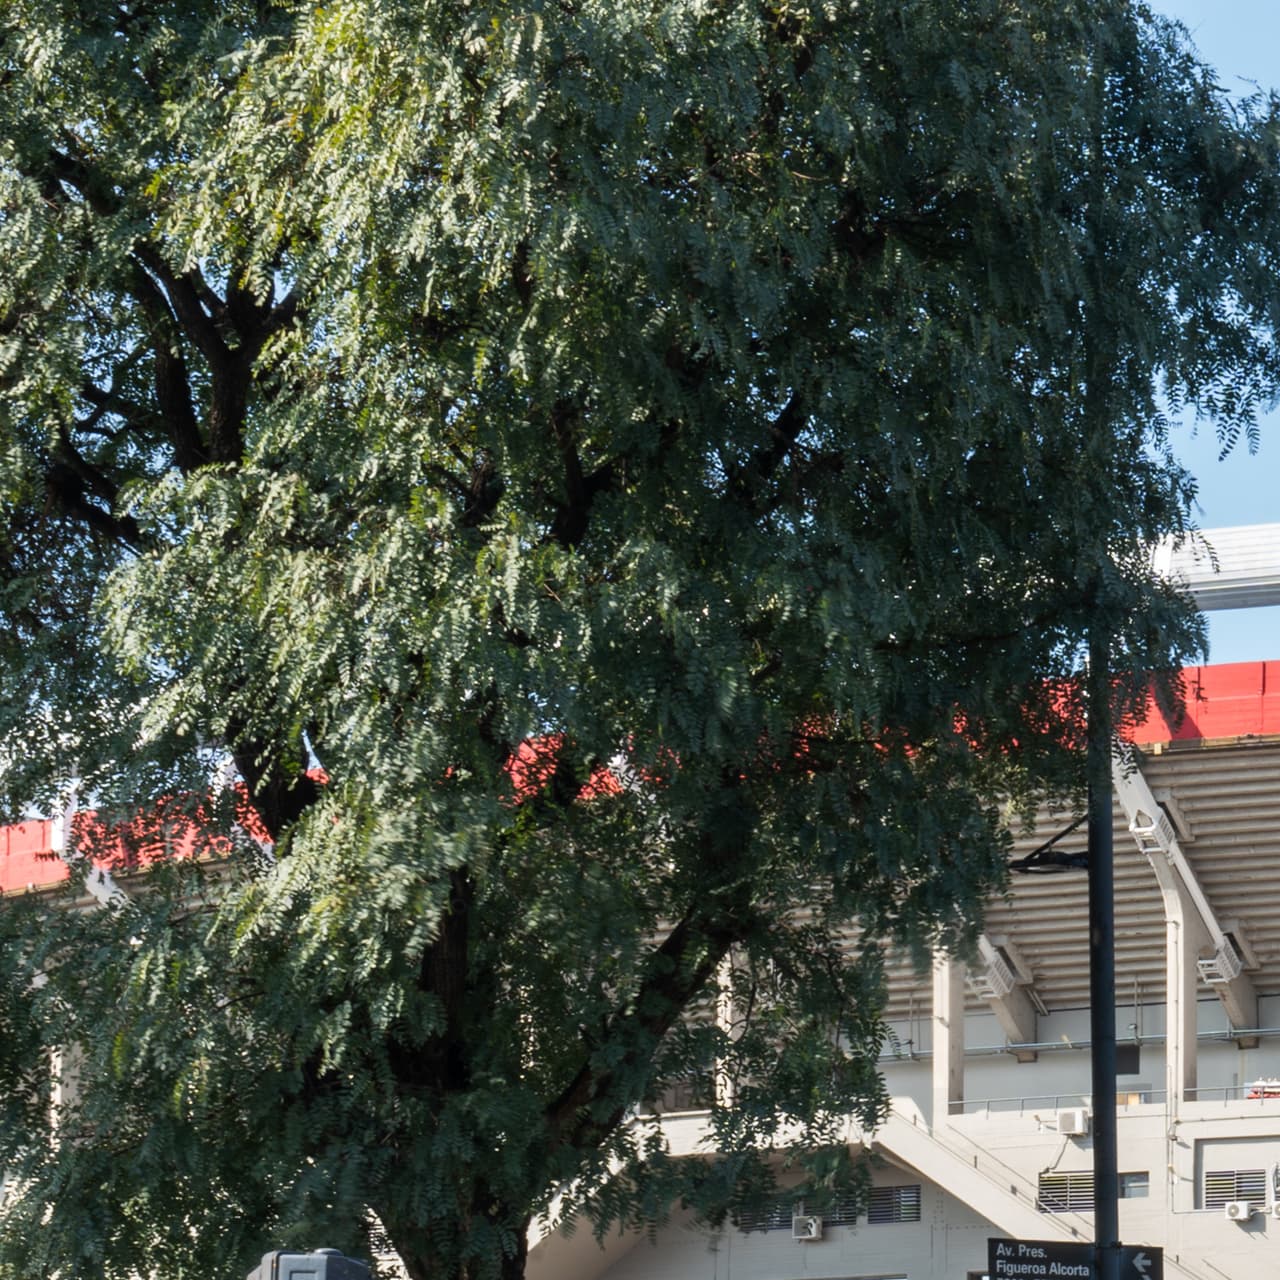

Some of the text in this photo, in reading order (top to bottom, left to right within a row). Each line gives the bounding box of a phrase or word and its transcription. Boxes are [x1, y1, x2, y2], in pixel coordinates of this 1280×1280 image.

[996, 1243, 1047, 1258] Av. Pres.
[996, 1260, 1090, 1276] Figueroa Alcorta
